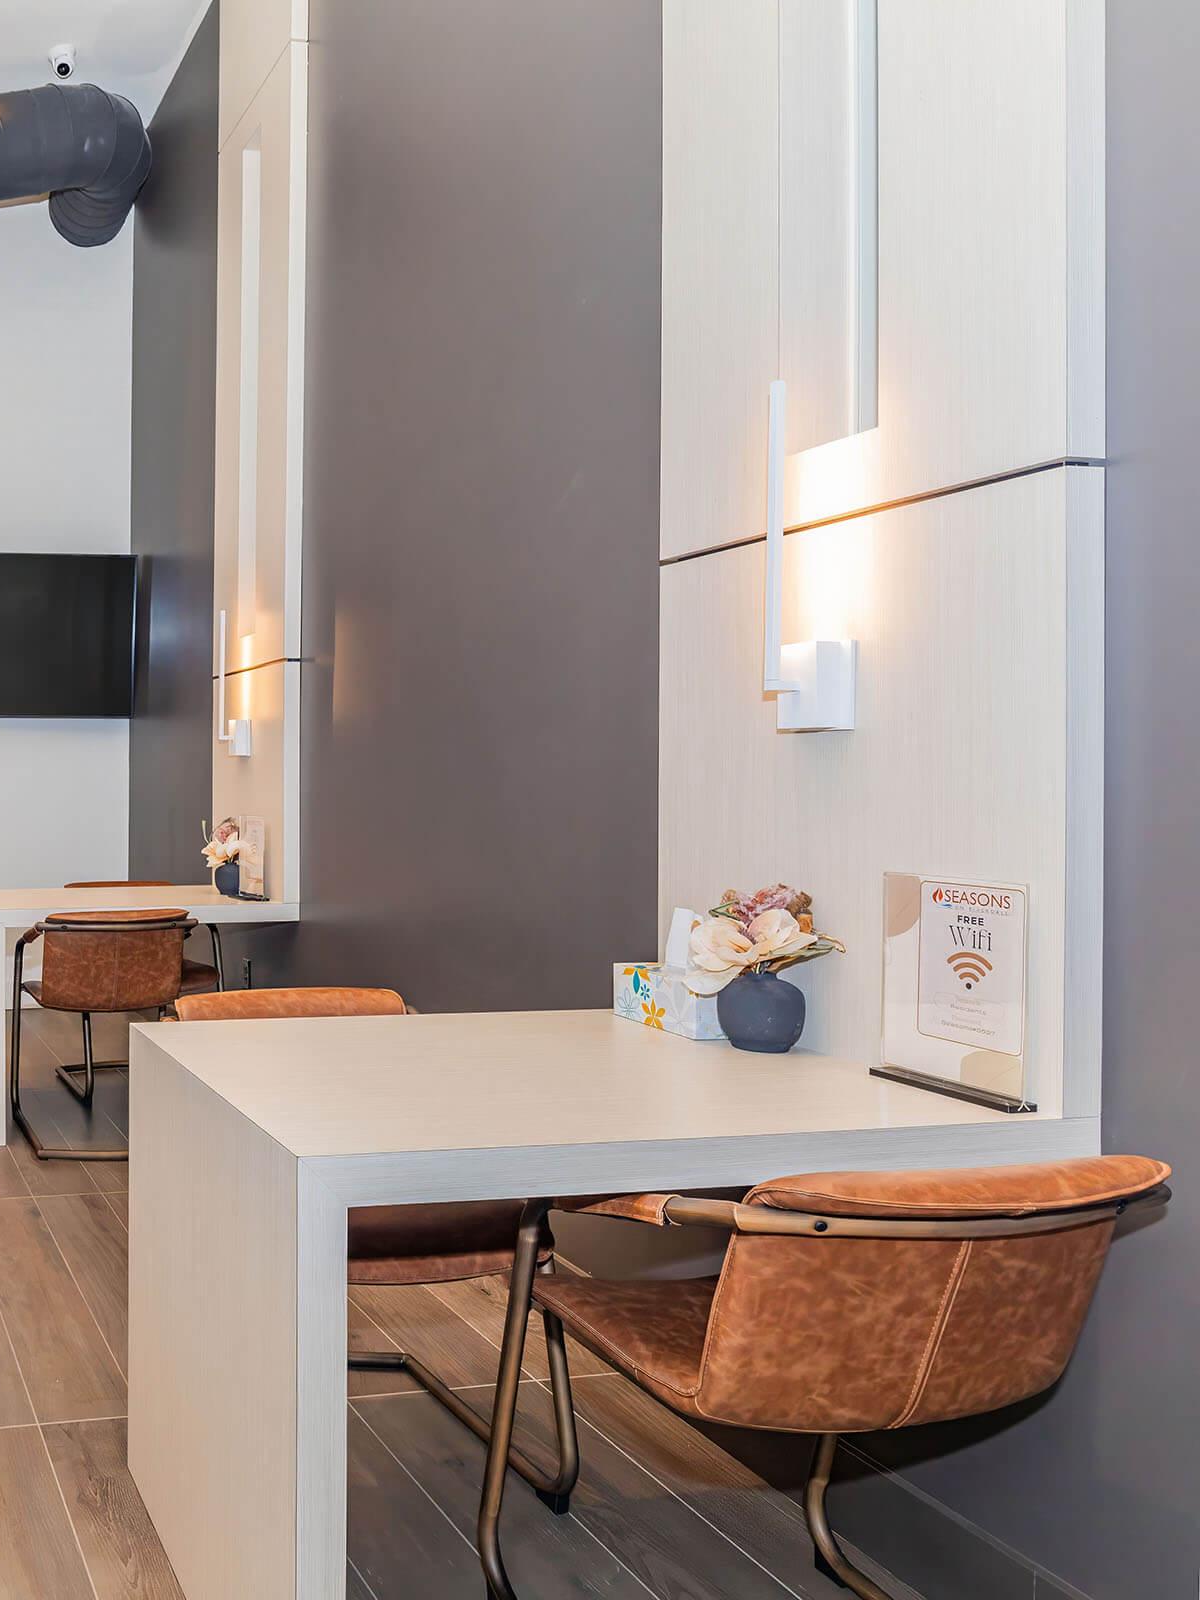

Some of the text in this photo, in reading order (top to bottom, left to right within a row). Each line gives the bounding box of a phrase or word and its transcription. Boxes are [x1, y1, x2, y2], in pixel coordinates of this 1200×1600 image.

[944, 889, 1011, 909] SEASONS
[957, 914, 985, 926] FREE
[949, 924, 992, 951] Wifi
